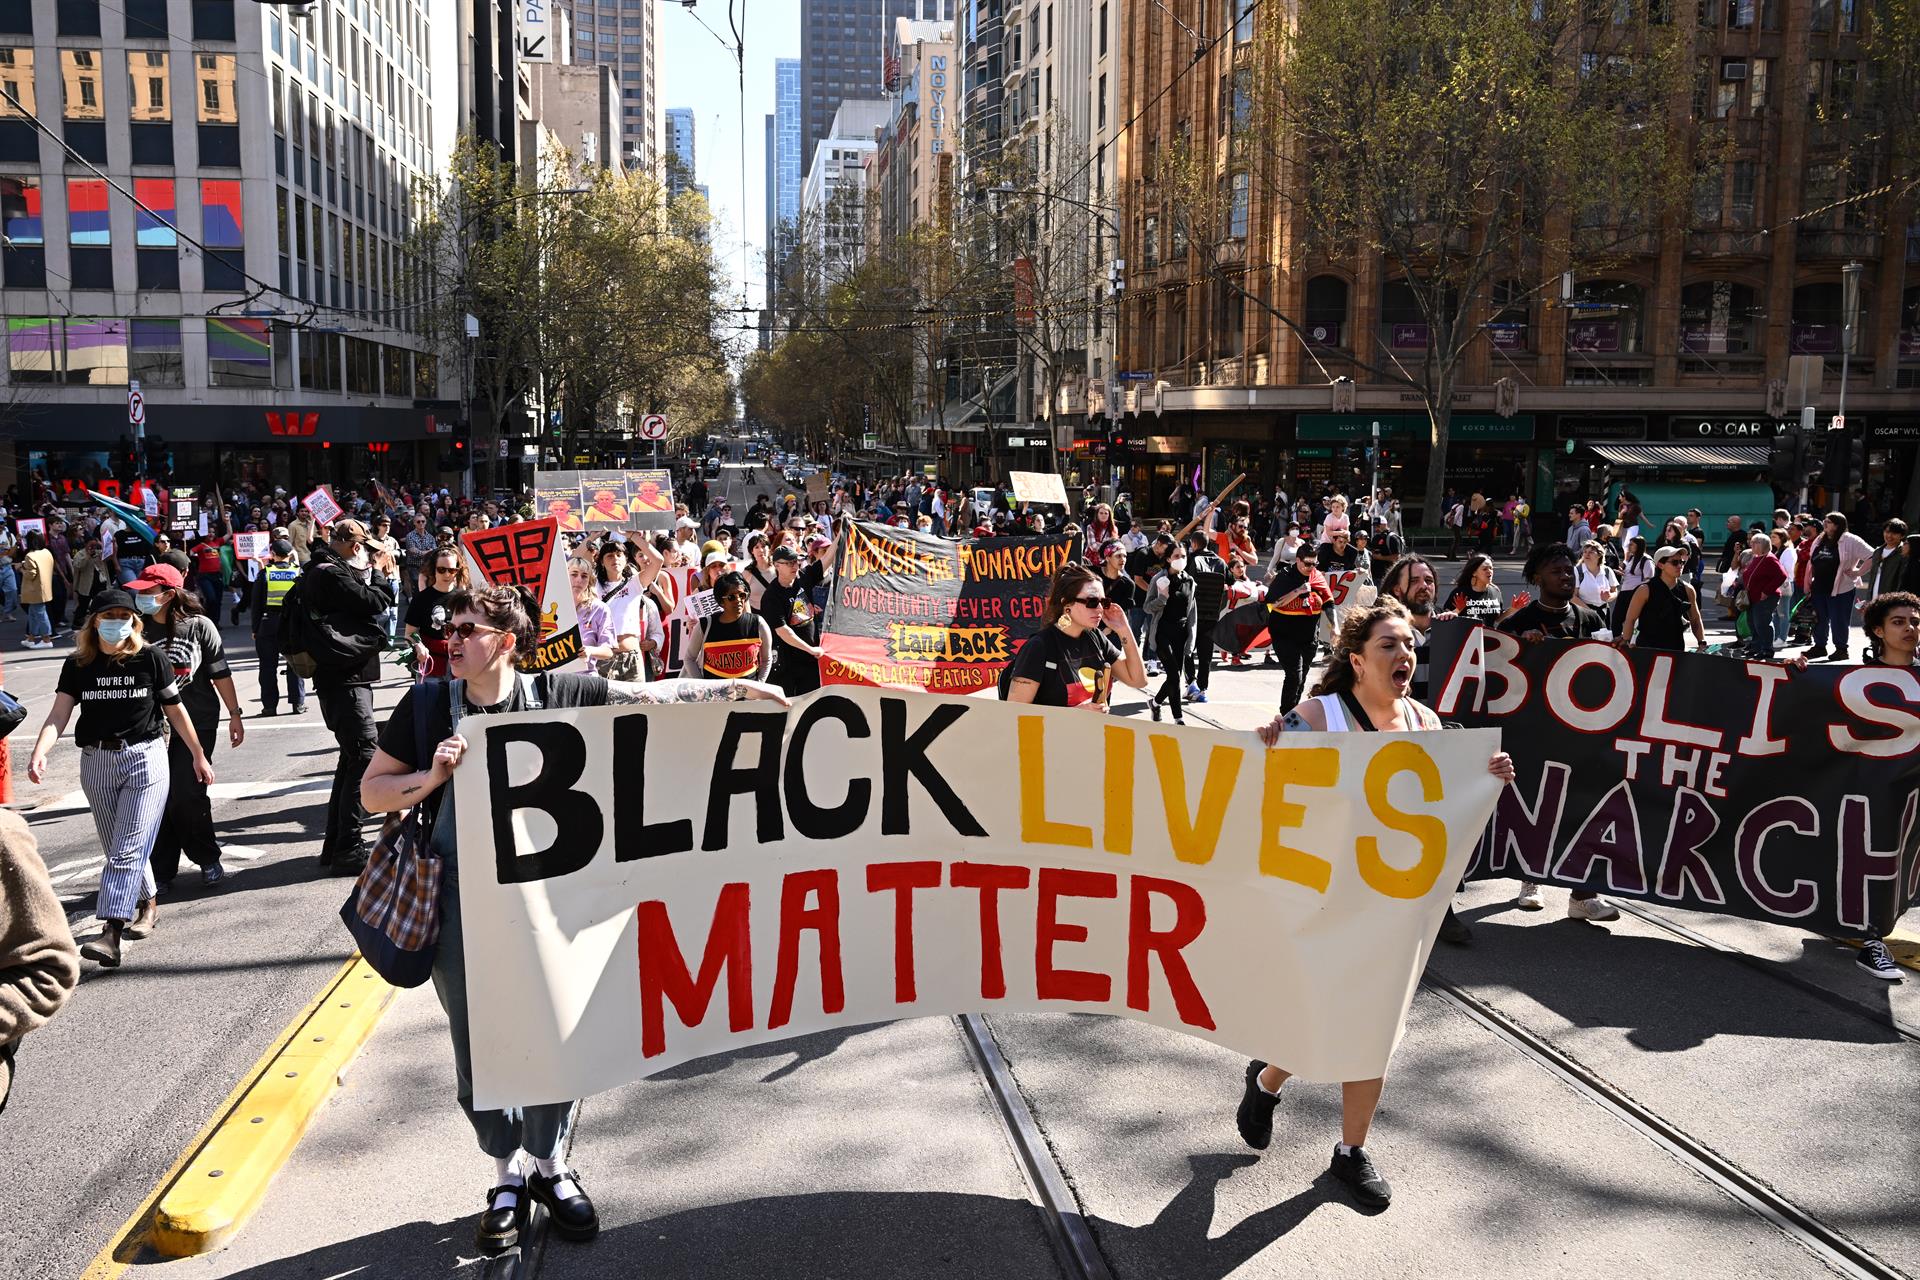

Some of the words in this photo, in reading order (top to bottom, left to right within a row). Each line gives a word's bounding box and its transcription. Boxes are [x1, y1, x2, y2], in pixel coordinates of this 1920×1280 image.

[931, 56, 946, 154] NOVOTE
[1029, 439, 1048, 447] BOSS
[1698, 422, 1761, 436] OSCAR
[270, 572, 295, 580] Police
[956, 539, 1073, 582] MONARCHY
[842, 584, 942, 618] SOVEREIGNTY
[946, 596, 1004, 619] NEVER
[898, 626, 946, 657] Land
[96, 676, 122, 687] YOU'RE
[124, 675, 135, 686] ON
[826, 660, 867, 683] STOP
[871, 662, 922, 685] BLACK
[923, 666, 983, 688] DEATHS
[82, 689, 127, 700] INDIGENOUS
[128, 687, 148, 698] LAND
[1615, 738, 1732, 798] THE
[486, 695, 991, 885] BLACK
[1017, 715, 1448, 900] LIVES
[1464, 760, 1918, 931] NARCH
[636, 860, 1217, 1060] MATTER
